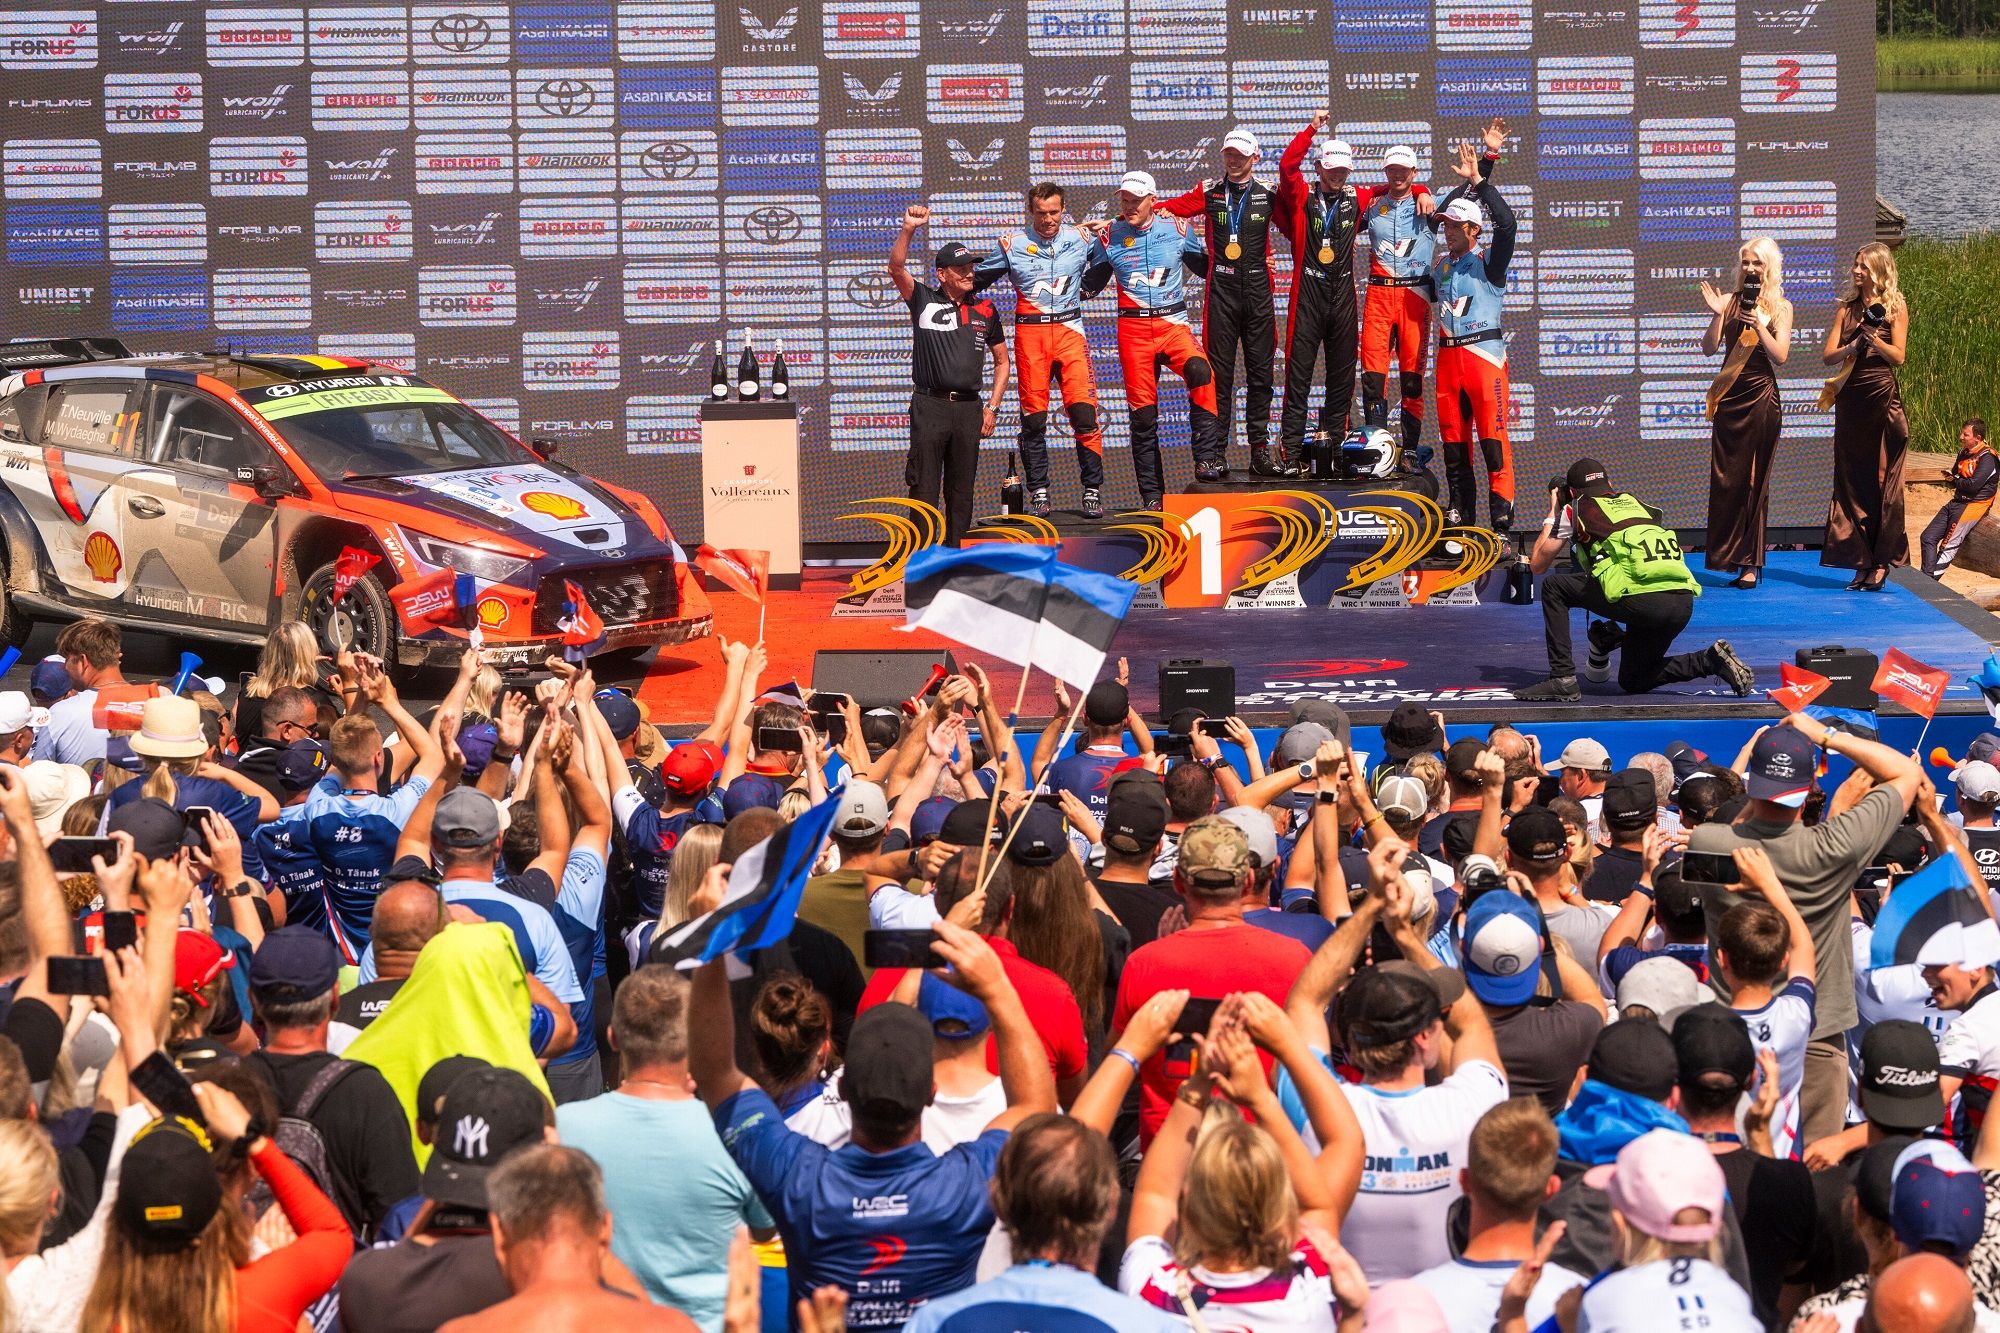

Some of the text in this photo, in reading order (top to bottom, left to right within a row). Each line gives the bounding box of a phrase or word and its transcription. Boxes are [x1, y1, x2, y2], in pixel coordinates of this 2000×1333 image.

[1243, 9, 1317, 26] UNIBET
[10, 40, 76, 56] FORUS
[742, 44, 797, 52] CASTORE
[1346, 73, 1420, 89] UNIBET
[1775, 59, 1801, 102] 3
[325, 95, 397, 107] CRAMO
[115, 105, 181, 120] FORUS
[1048, 149, 1089, 162] CIRCLE
[1652, 142, 1723, 154] CRAMO
[221, 171, 286, 184] FORUS
[330, 173, 369, 181] LUBRICANTS
[1549, 201, 1623, 217] UNIBET
[326, 235, 391, 247] FORUS
[1651, 267, 1723, 279] UNIBET
[19, 288, 94, 304] UNIBET
[430, 298, 494, 312] FORUS
[1464, 320, 1489, 331] MOBIS
[1553, 332, 1620, 355] Delfi
[534, 361, 598, 376] FORUS
[302, 377, 375, 392] HYUNDAI
[60, 403, 112, 425] T.Neuville
[45, 418, 106, 444] M.Wydaeghe
[124, 411, 141, 452] 1
[229, 396, 289, 456] motorsport.hyundai.com
[531, 421, 613, 431] FORUM8
[237, 469, 252, 480] ixo
[465, 473, 562, 490] MOBIS
[710, 486, 790, 497] Vollereaux
[385, 527, 404, 554] HYUNDAI
[383, 536, 406, 568] WIA
[1181, 507, 1222, 595] 1
[1637, 537, 1681, 563] 149
[136, 595, 249, 622] HYUNDAI MOBIS
[1264, 678, 1397, 687] Delfi
[1091, 795, 1108, 804] Del
[334, 826, 363, 843] #8
[1120, 826, 1134, 834] POLO
[289, 868, 315, 882] Tänak
[347, 868, 380, 878] Tänak
[1758, 1023, 1771, 1042] 8
[1875, 1065, 1938, 1086] Titleist
[853, 1194, 909, 1211] WRC
